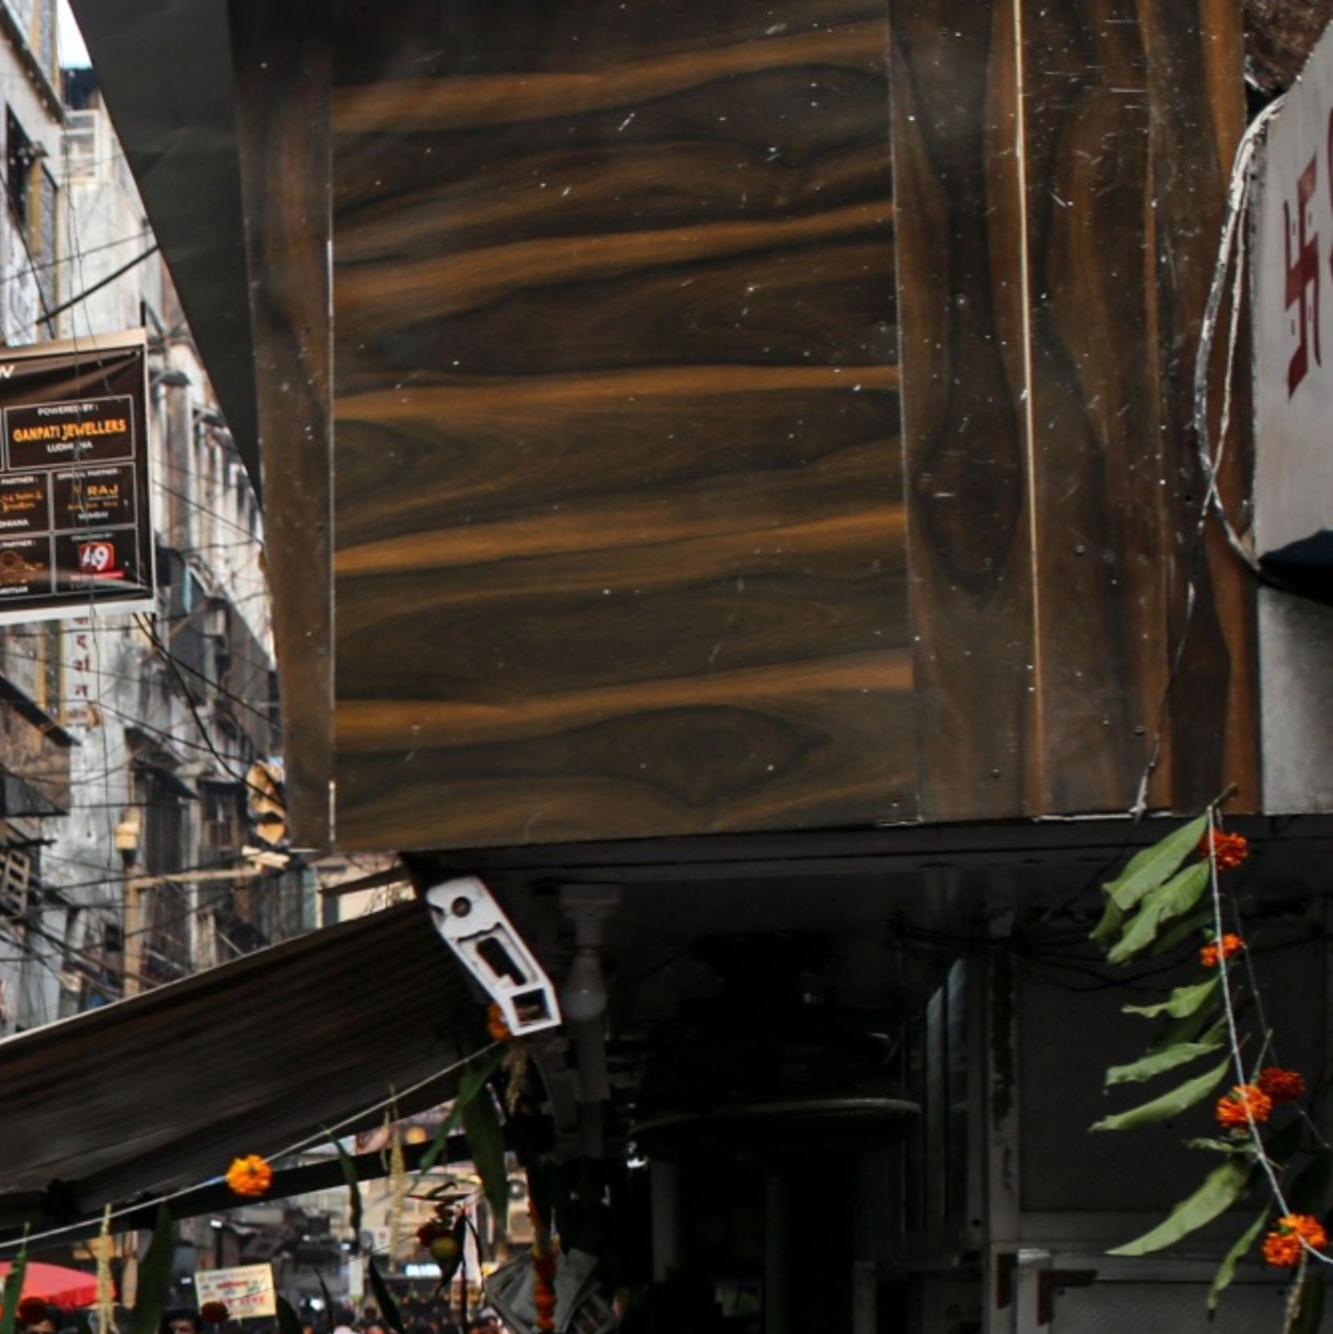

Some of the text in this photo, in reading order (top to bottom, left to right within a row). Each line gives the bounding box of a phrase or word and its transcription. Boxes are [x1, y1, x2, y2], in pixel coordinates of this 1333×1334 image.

[37, 405, 79, 416] POWERED
[13, 418, 127, 443] GANPATI JEWELLERS
[87, 484, 119, 497] RAJ
